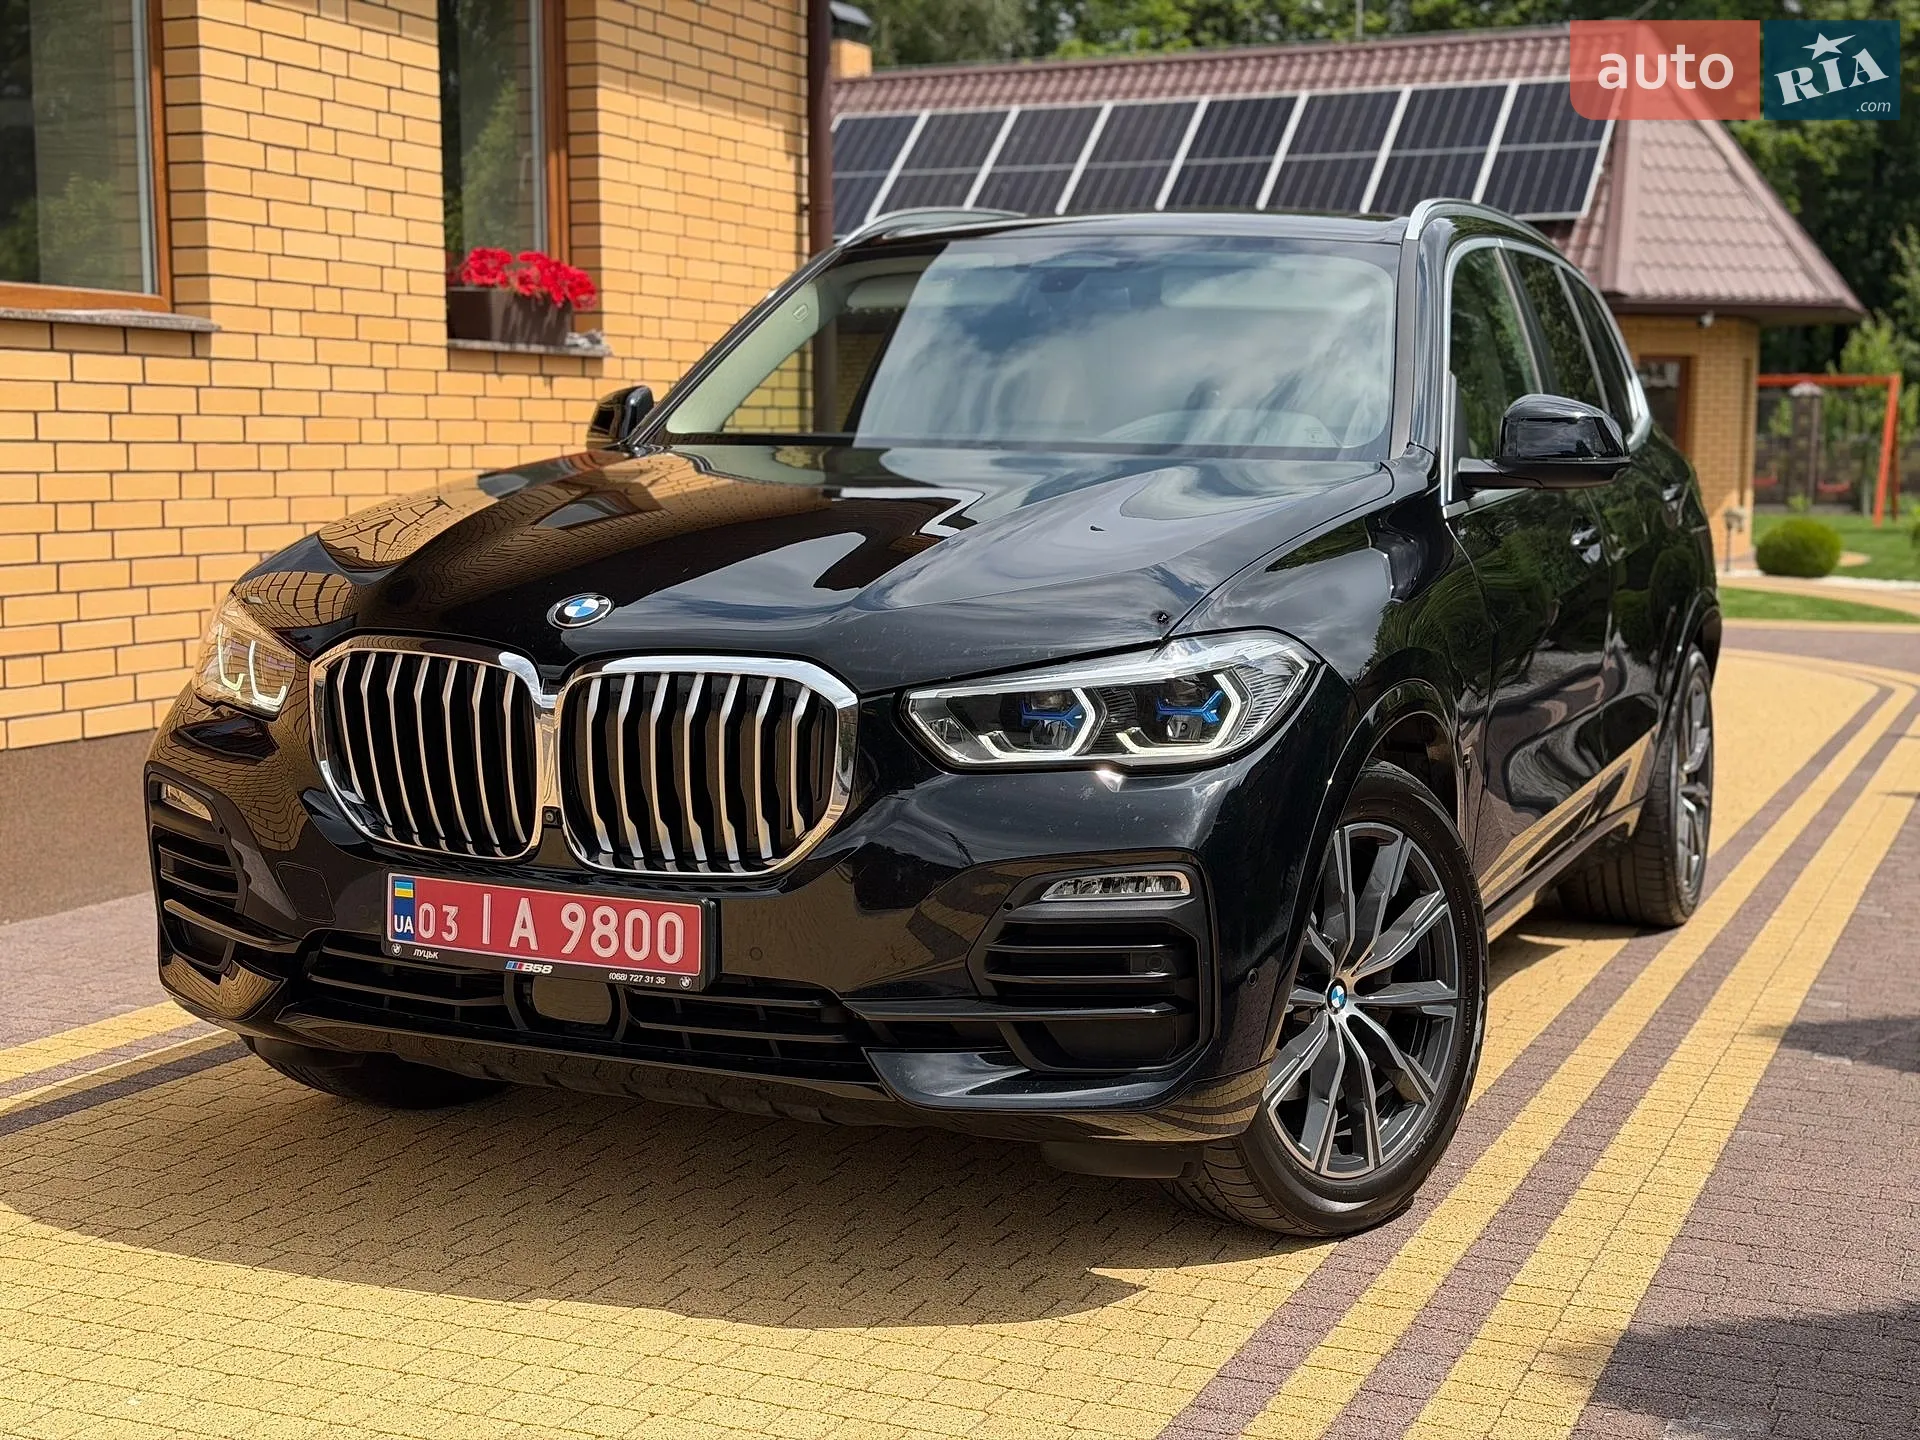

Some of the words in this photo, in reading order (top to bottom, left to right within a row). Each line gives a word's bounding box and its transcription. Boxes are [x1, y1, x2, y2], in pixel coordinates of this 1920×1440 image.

[394, 914, 415, 934] UA
[418, 902, 459, 942] 03
[560, 902, 684, 964] 9800
[413, 948, 439, 960] ЛУЦЬК
[523, 962, 553, 974] B58
[629, 974, 644, 982] 727
